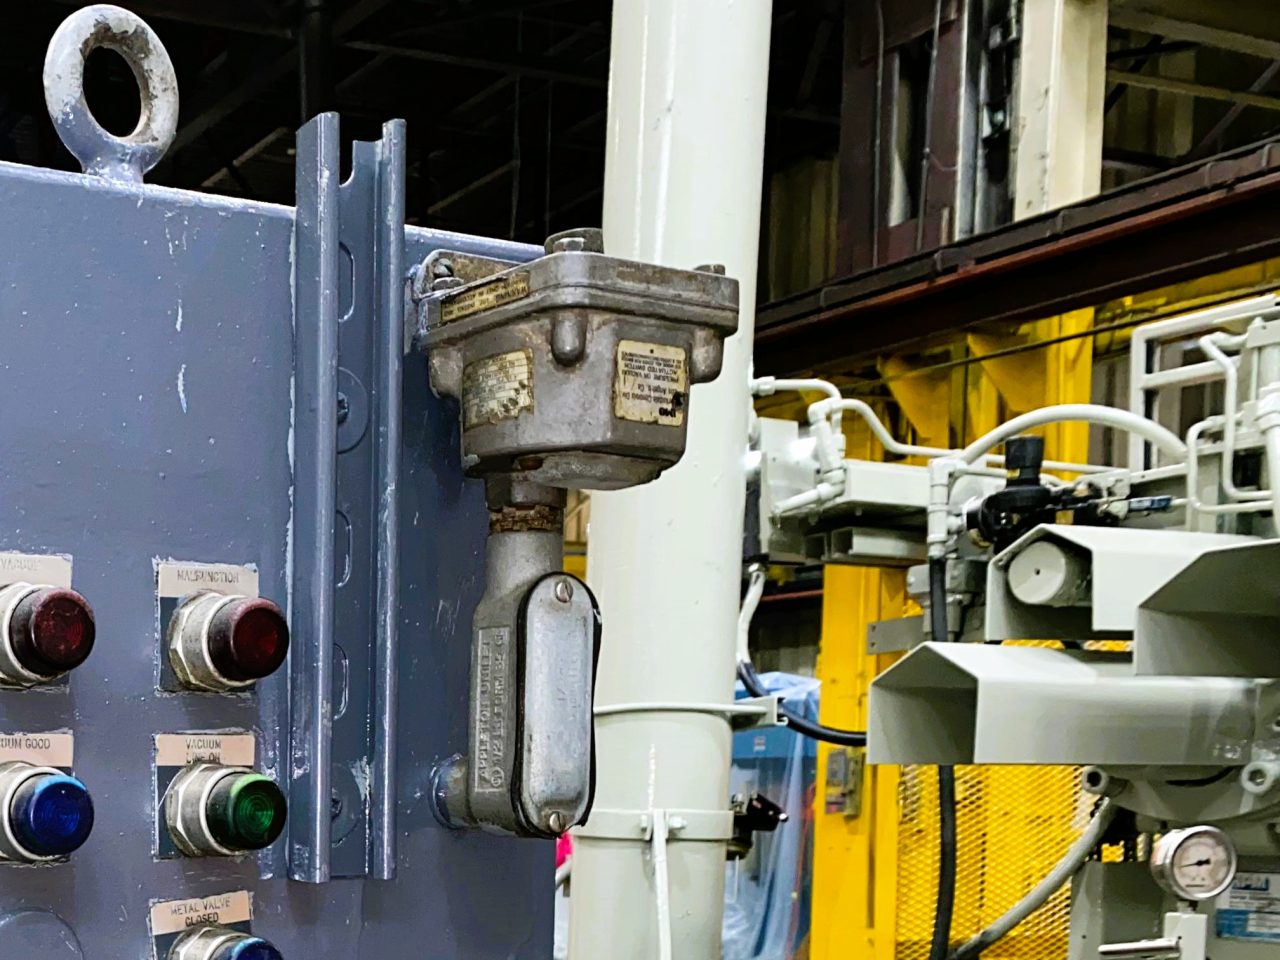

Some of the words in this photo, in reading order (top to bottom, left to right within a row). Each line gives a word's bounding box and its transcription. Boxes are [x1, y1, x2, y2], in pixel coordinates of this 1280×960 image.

[176, 569, 240, 584] MALFUNCTION
[25, 738, 51, 750] GOOD
[185, 739, 222, 750] VACUUM
[170, 903, 201, 915] METAL
[202, 897, 232, 911] VALVE
[185, 912, 220, 927] CLOSED
